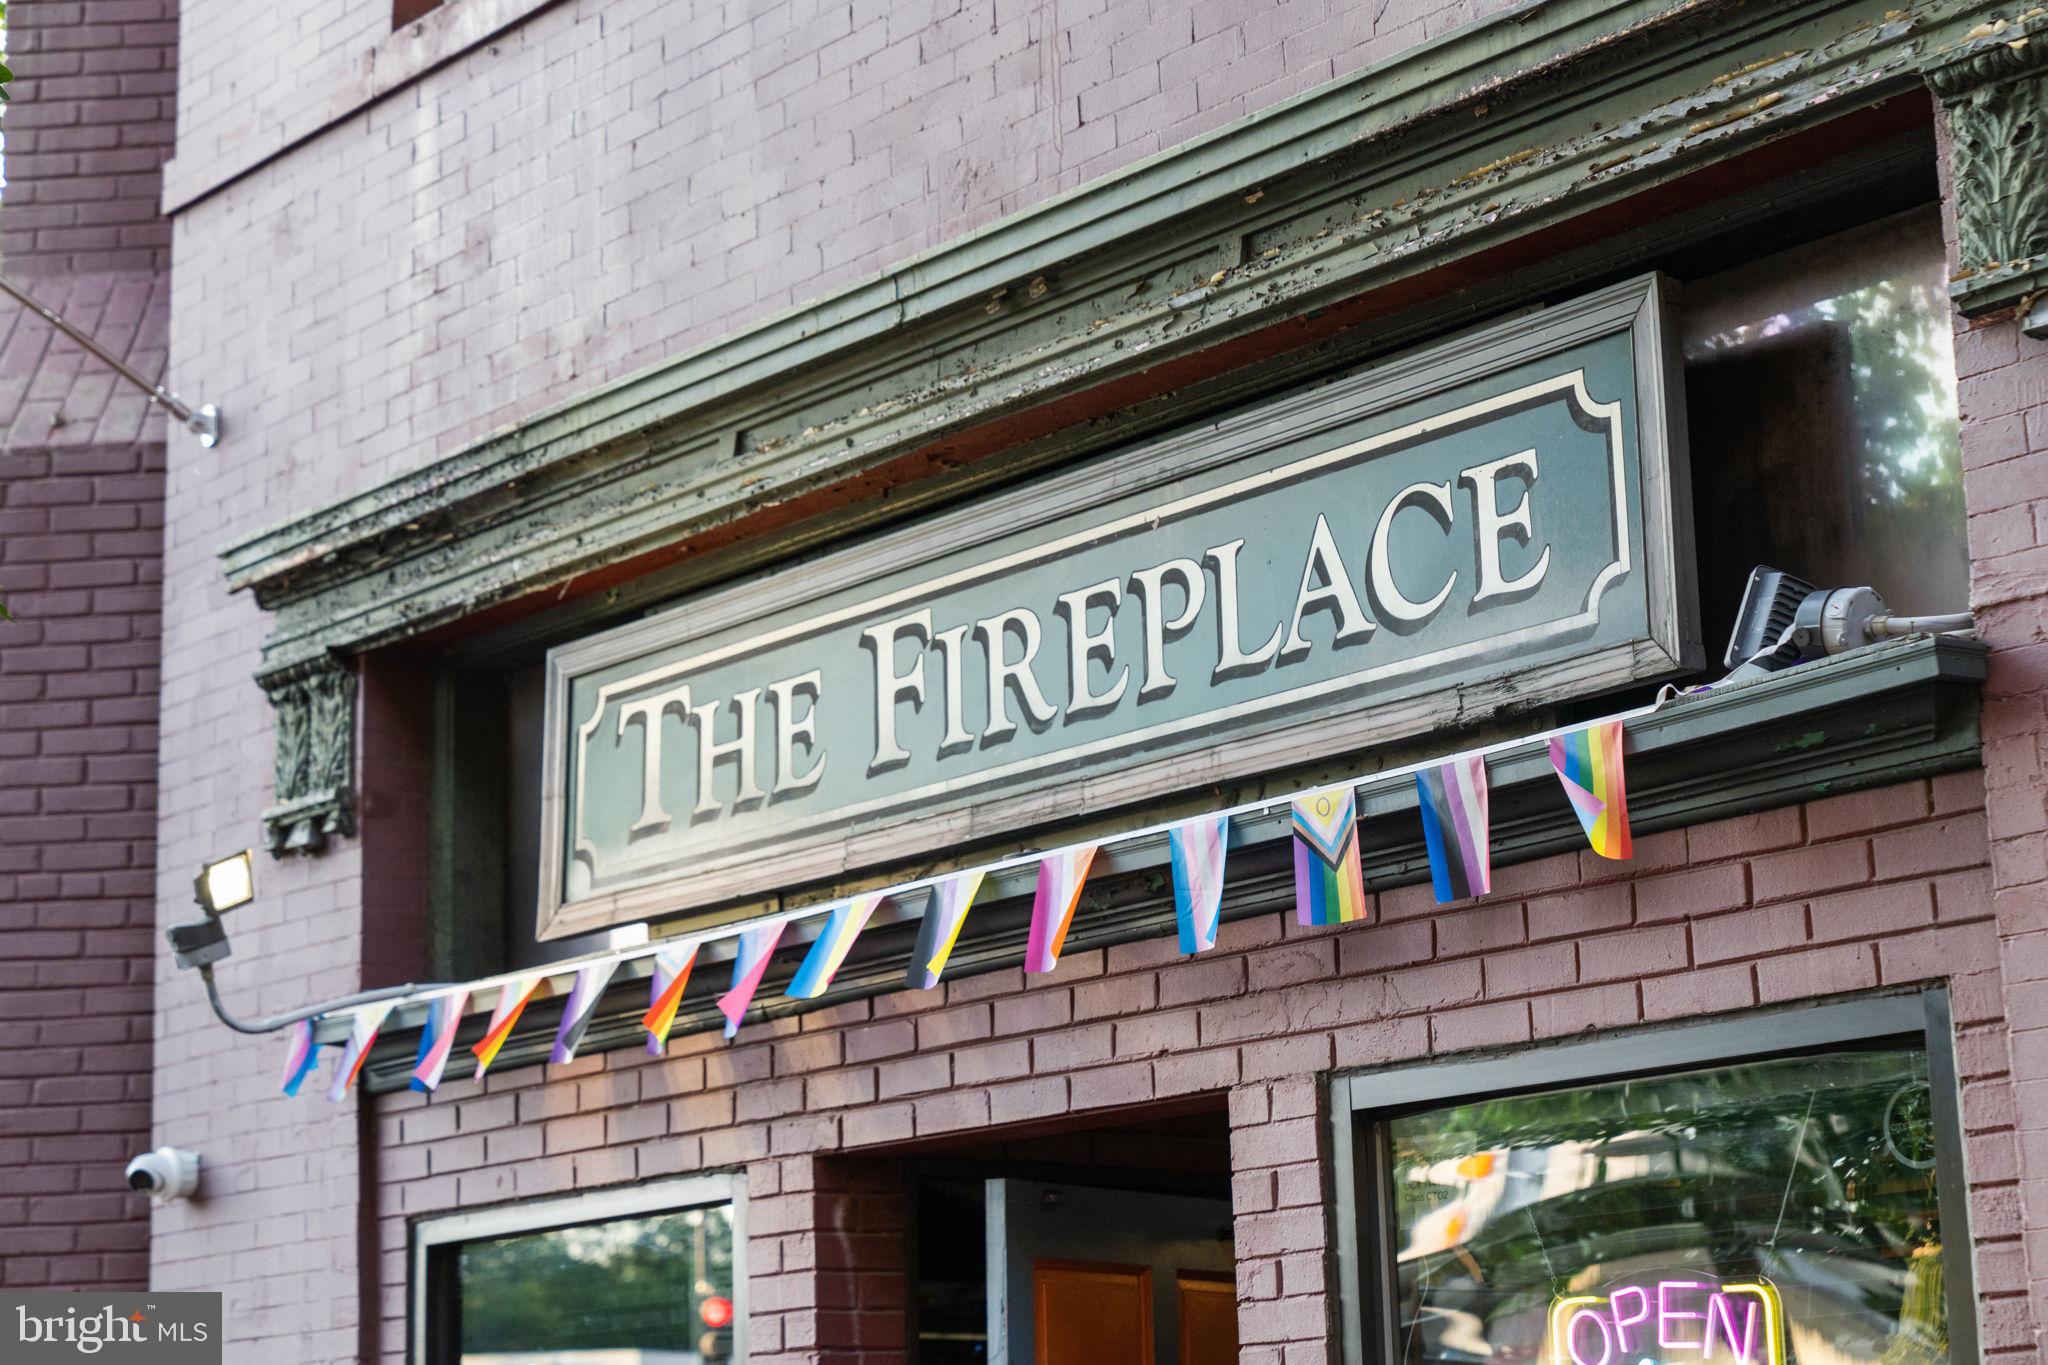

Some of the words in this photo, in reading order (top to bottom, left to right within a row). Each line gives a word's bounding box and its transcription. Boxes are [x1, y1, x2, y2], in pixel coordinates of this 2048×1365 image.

[616, 668, 828, 840] THE
[859, 447, 1551, 776] FIREPLACE
[1567, 1281, 1757, 1365] OPEN
